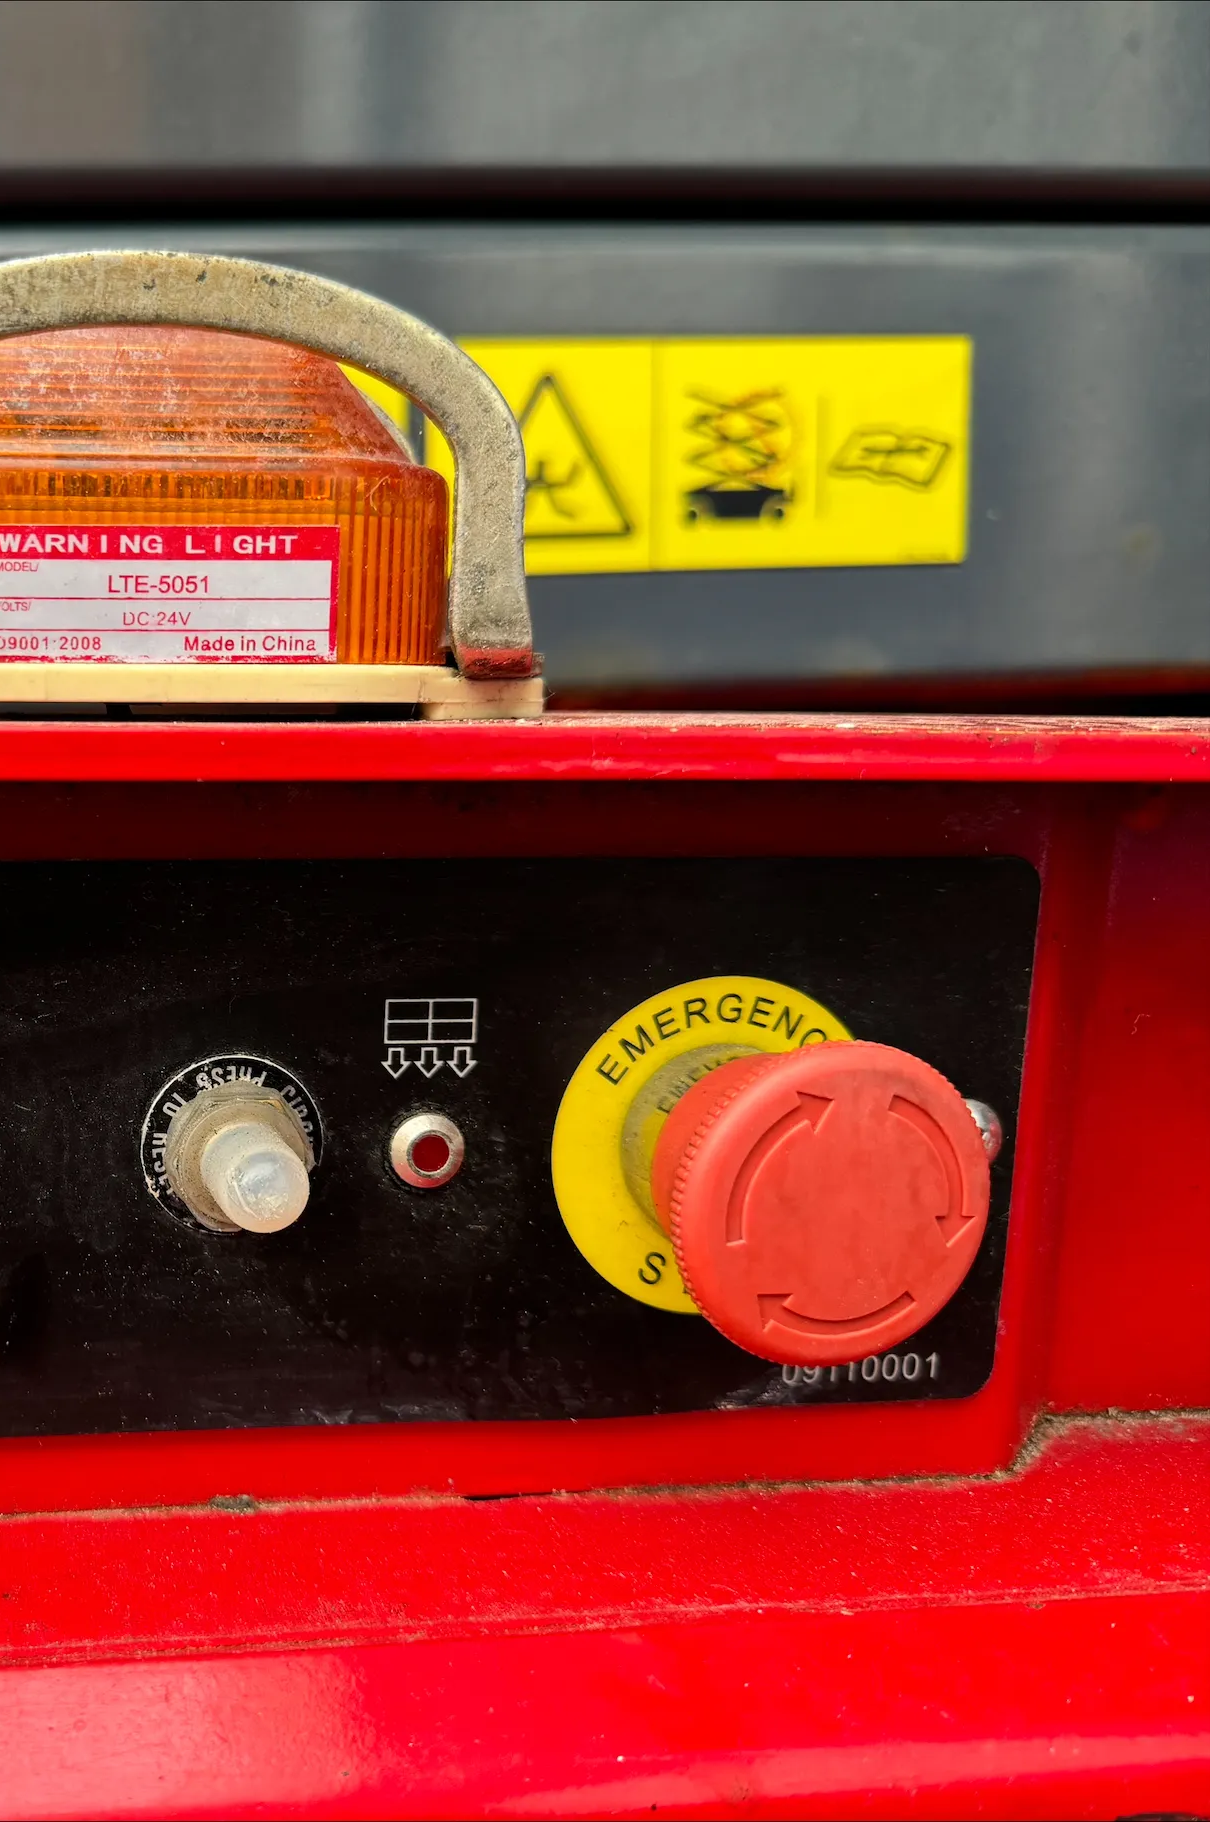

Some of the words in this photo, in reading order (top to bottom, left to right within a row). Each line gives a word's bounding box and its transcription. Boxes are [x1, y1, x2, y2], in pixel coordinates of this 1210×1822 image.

[185, 534, 299, 555] LIGHT
[108, 574, 210, 594] LTE-5051
[184, 636, 235, 652] Made
[241, 636, 256, 651] in
[262, 636, 317, 652] China
[595, 993, 828, 1086] EMERGENC
